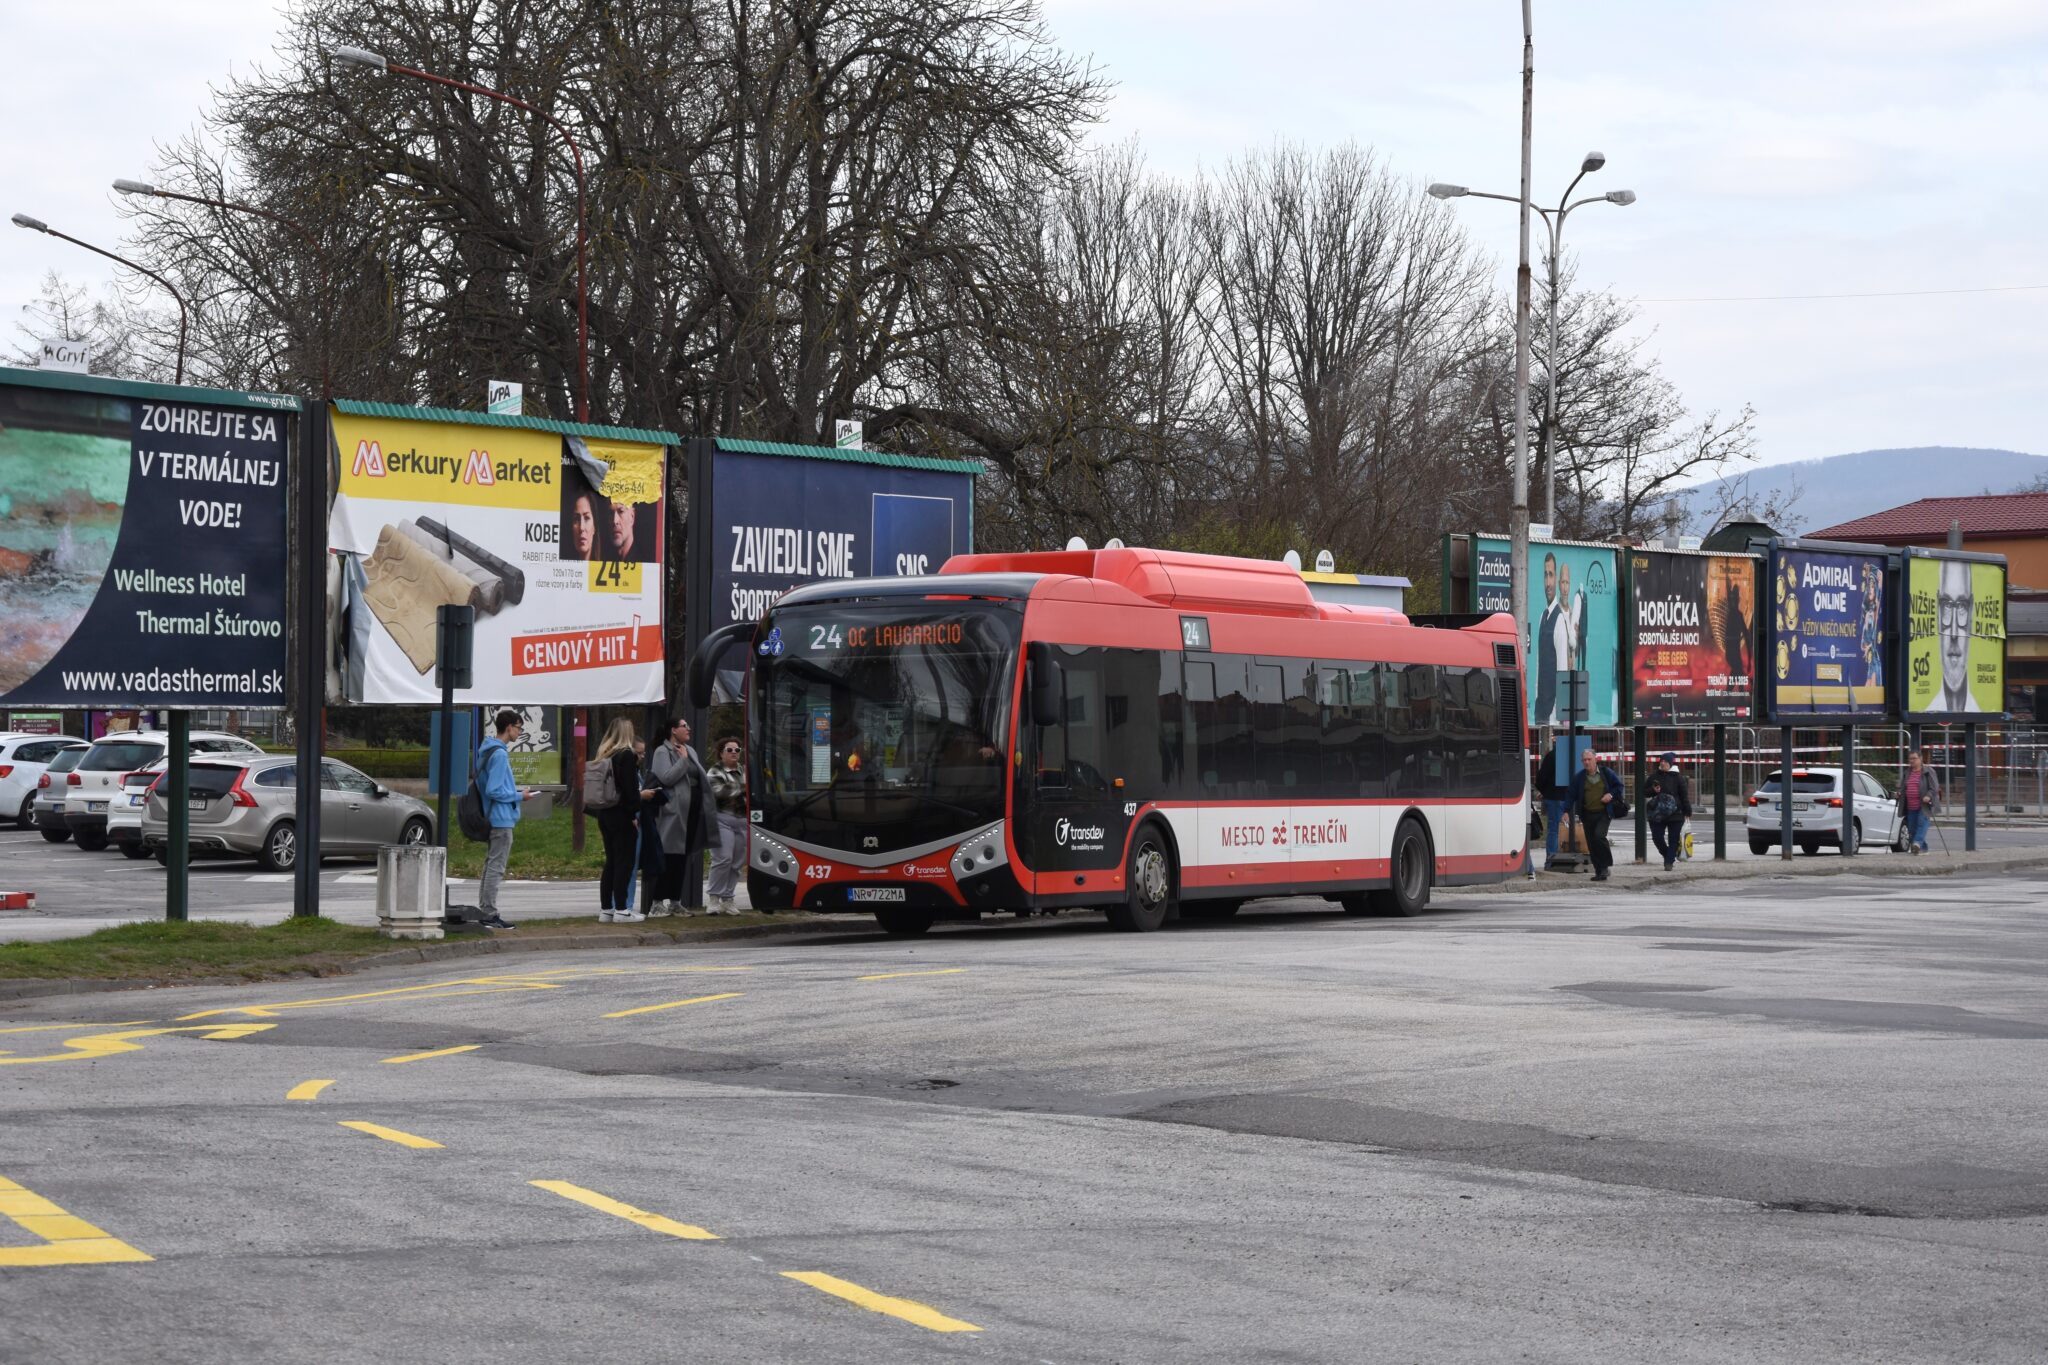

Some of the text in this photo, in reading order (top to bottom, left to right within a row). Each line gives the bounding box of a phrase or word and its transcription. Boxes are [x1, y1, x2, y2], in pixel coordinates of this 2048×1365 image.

[141, 405, 277, 441] ZOHREJTE SA
[138, 450, 280, 486] V TERMÁLNEJ
[352, 439, 551, 486] Merkury Market
[179, 499, 242, 529] VODE!
[525, 522, 559, 543] KOBE
[522, 551, 558, 563] RABBIT FUR
[731, 525, 854, 578] ZAVIEDLI SME
[114, 569, 246, 596] Wellness Hotel
[1590, 579, 1602, 594] 365
[1802, 562, 1857, 590] ADMIRAL
[1479, 599, 1484, 611] s
[1639, 594, 1699, 626] HORÚČKA
[1814, 590, 1847, 612] ONLINE
[1909, 590, 1936, 615] NIŽŠIE
[1975, 595, 2000, 619] VYŠŠIE
[136, 608, 281, 637] Thermal Štúrovo
[1184, 622, 1200, 646] 24
[1802, 618, 1857, 637] VŽDY NIEČO NOVÉ
[1909, 617, 1936, 642] DANE
[810, 624, 960, 649] 24 OC LAUGARICIO
[1684, 632, 1700, 645] NOCI
[523, 632, 593, 669] CENOVÝ
[1658, 651, 1670, 665] BEE
[1671, 651, 1688, 665] GEES
[62, 667, 283, 694] www.vadasthermal.sk
[1123, 802, 1136, 816] 437
[1070, 825, 1104, 840] transdev
[1222, 818, 1347, 847] MESTO TRENČÍN
[805, 865, 832, 879] 437
[916, 865, 947, 874] transdev
[854, 889, 904, 900] NR 722MA
